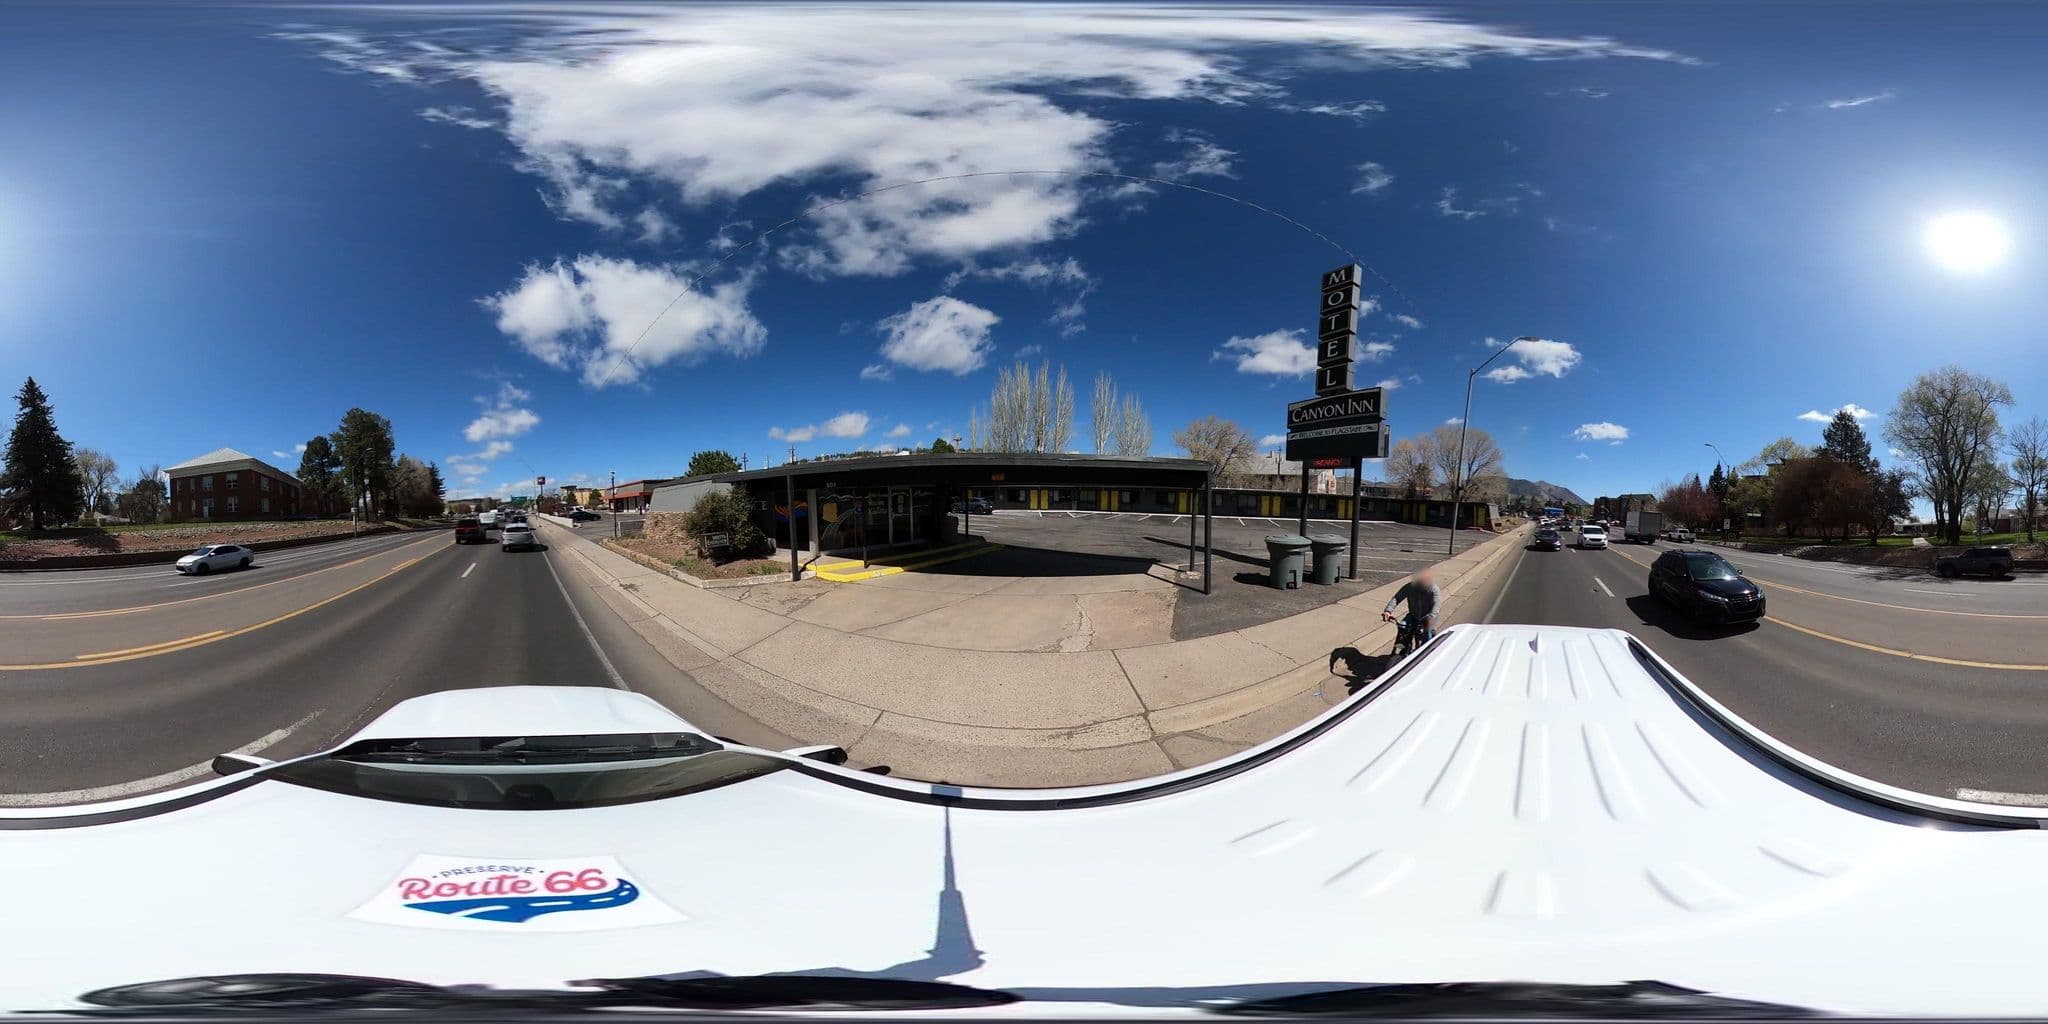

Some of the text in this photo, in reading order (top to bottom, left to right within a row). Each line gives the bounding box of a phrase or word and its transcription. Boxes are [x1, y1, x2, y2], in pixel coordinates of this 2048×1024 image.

[1326, 269, 1346, 387] MOTEL
[398, 868, 608, 900] Route 66
[441, 865, 535, 879] PRESERVE
